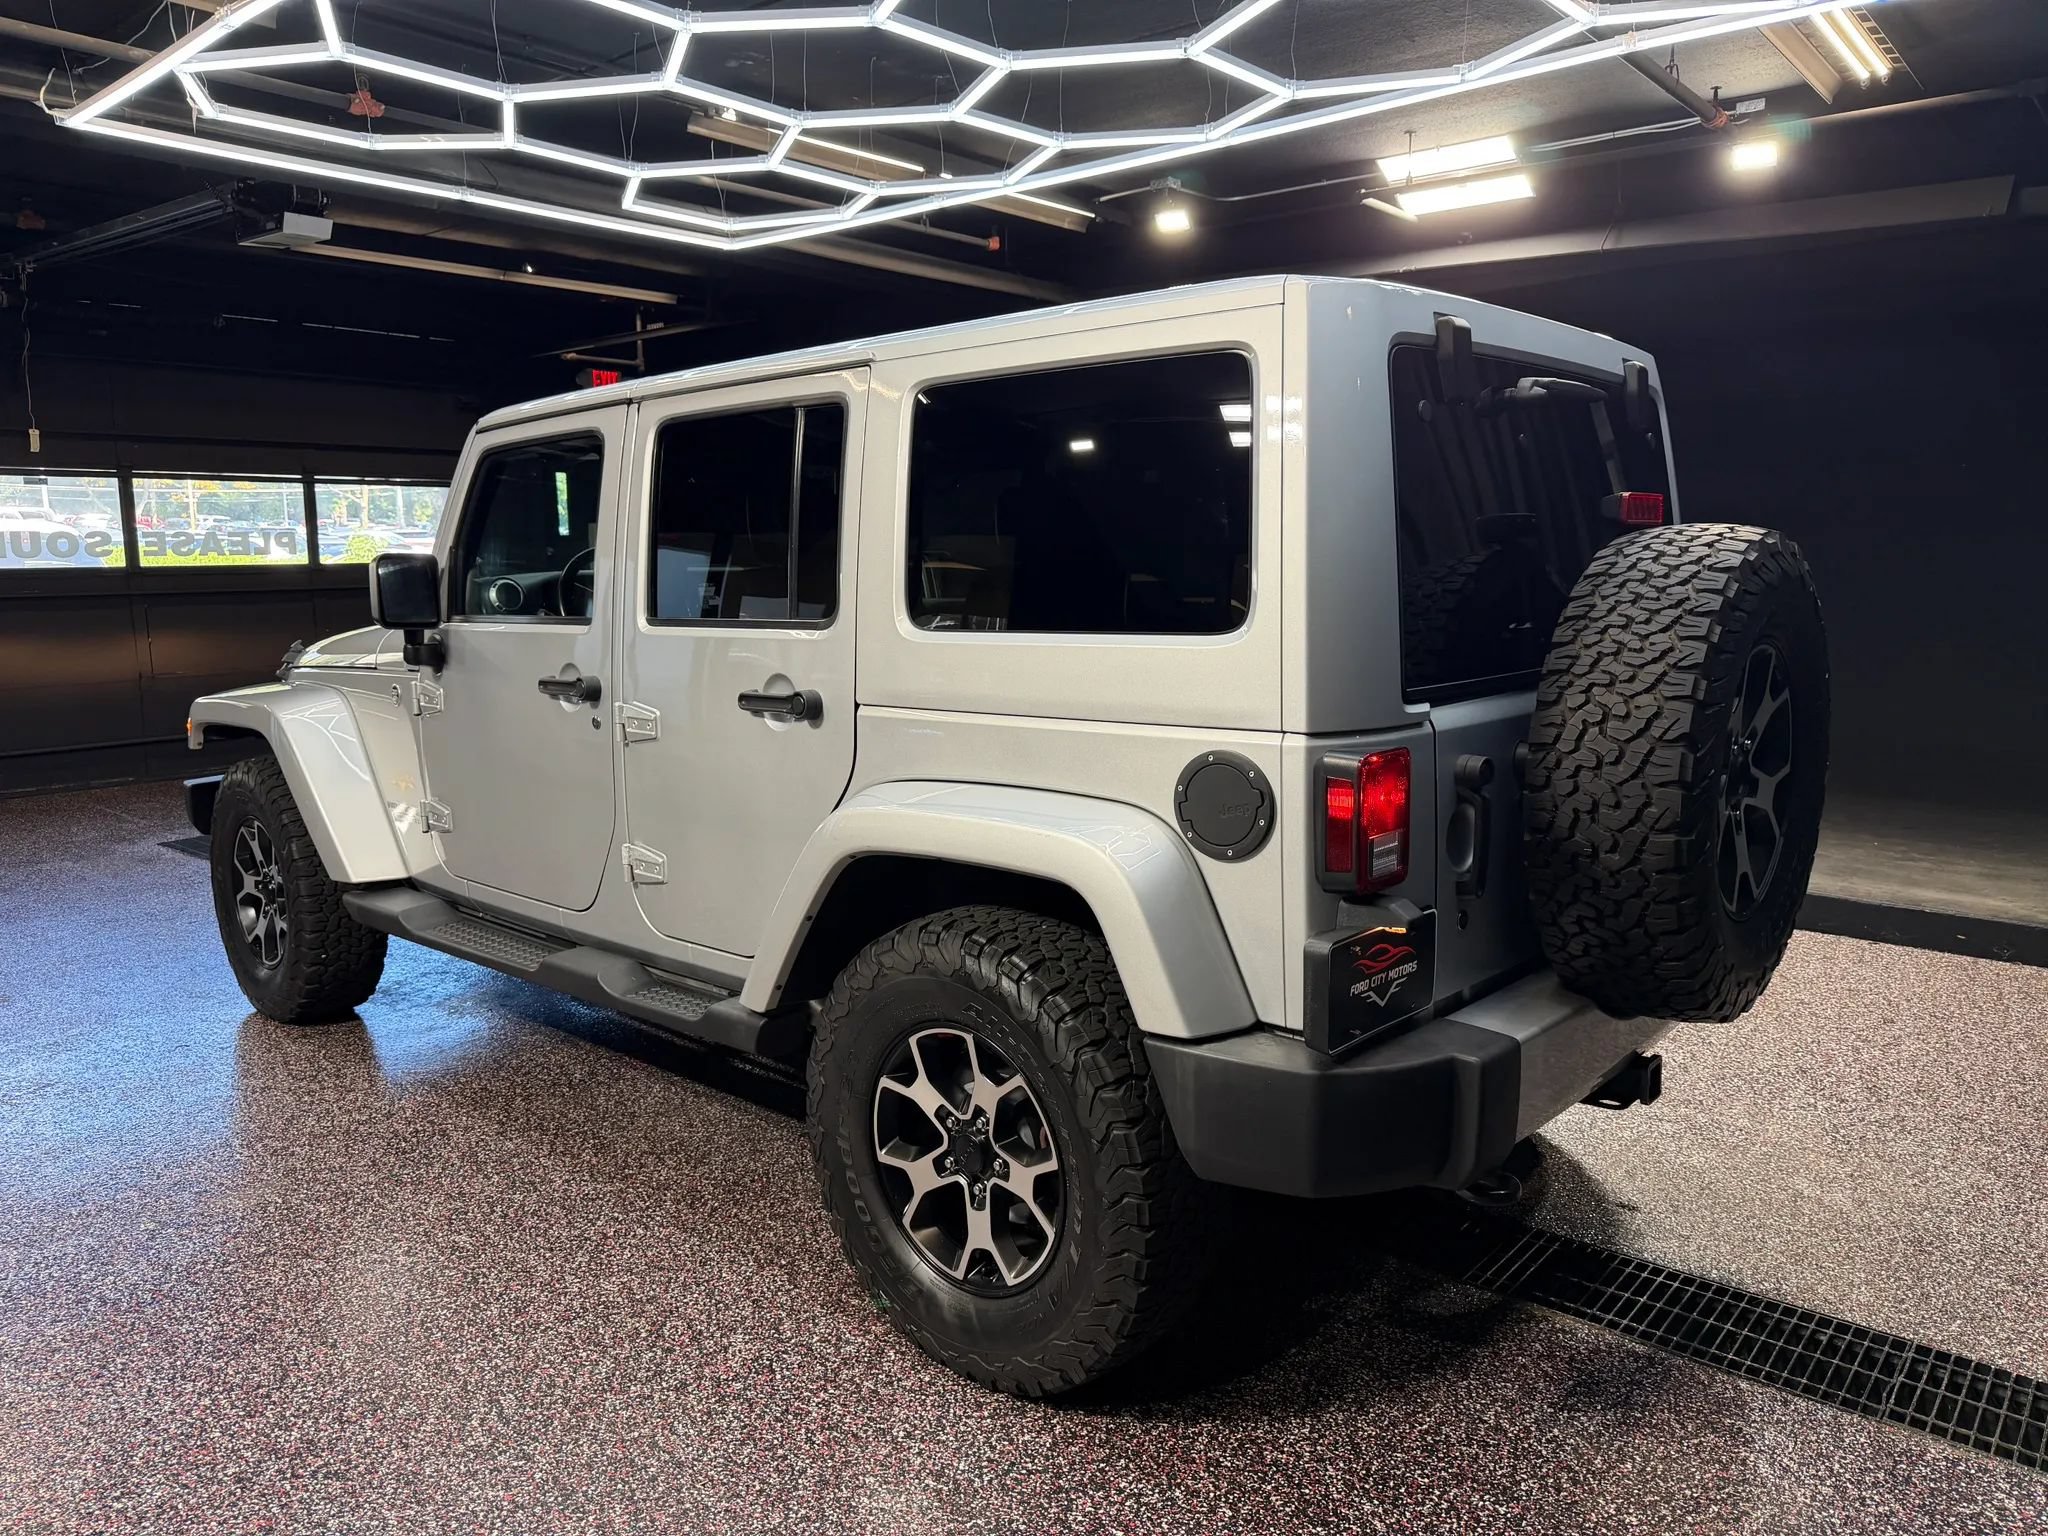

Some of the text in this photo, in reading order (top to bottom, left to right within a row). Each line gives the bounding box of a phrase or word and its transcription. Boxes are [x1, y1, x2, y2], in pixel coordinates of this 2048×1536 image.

[1349, 960, 1418, 997] FORD CITY MOTORS
